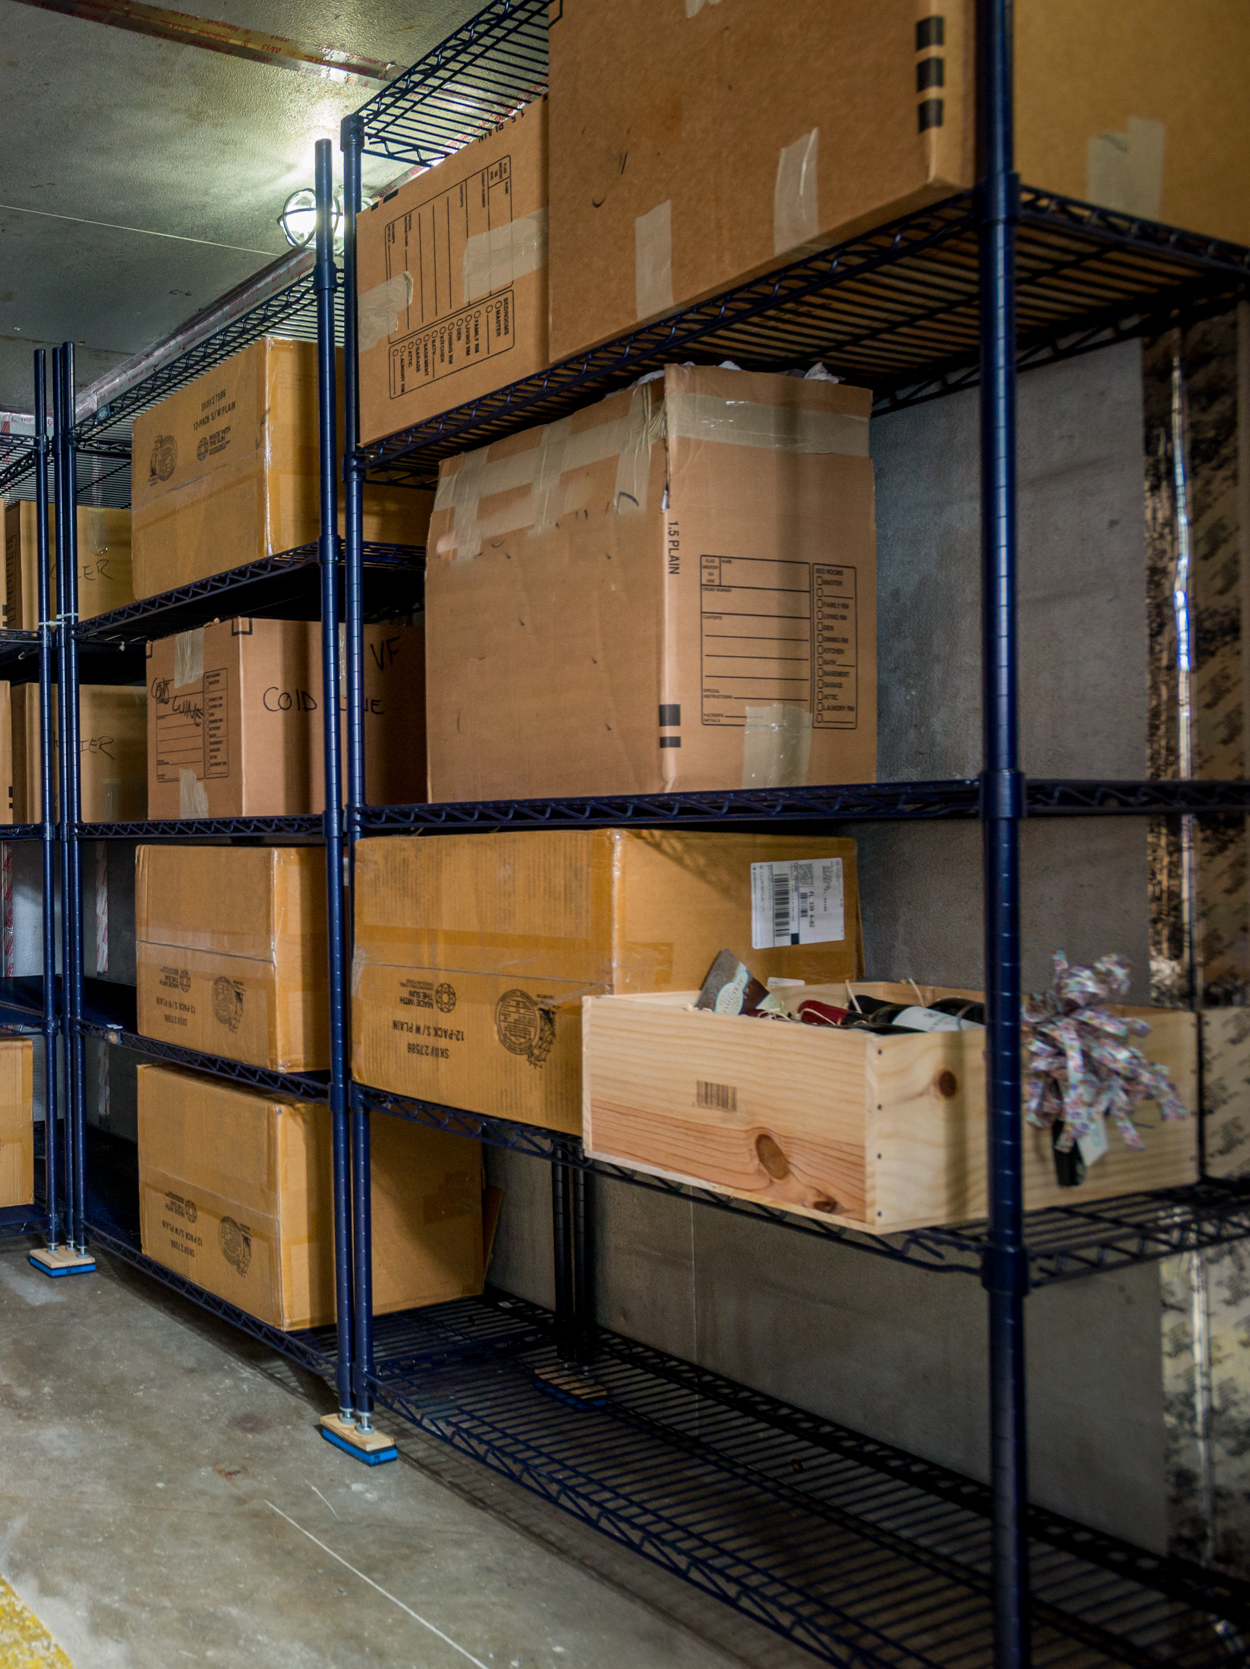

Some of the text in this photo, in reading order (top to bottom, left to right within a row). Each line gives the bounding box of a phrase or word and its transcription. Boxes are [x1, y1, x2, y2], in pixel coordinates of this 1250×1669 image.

[466, 346, 471, 356] RM
[475, 343, 480, 354] RM
[448, 354, 453, 365] RM
[400, 383, 405, 393] RM
[221, 400, 236, 415] PLAIN
[668, 521, 680, 575] 1.5 PLAIN
[409, 990, 434, 1000] THE SUN
[400, 996, 434, 1009] MADE WITH
[393, 1020, 464, 1041] 12-PACK S/W PLAIN
